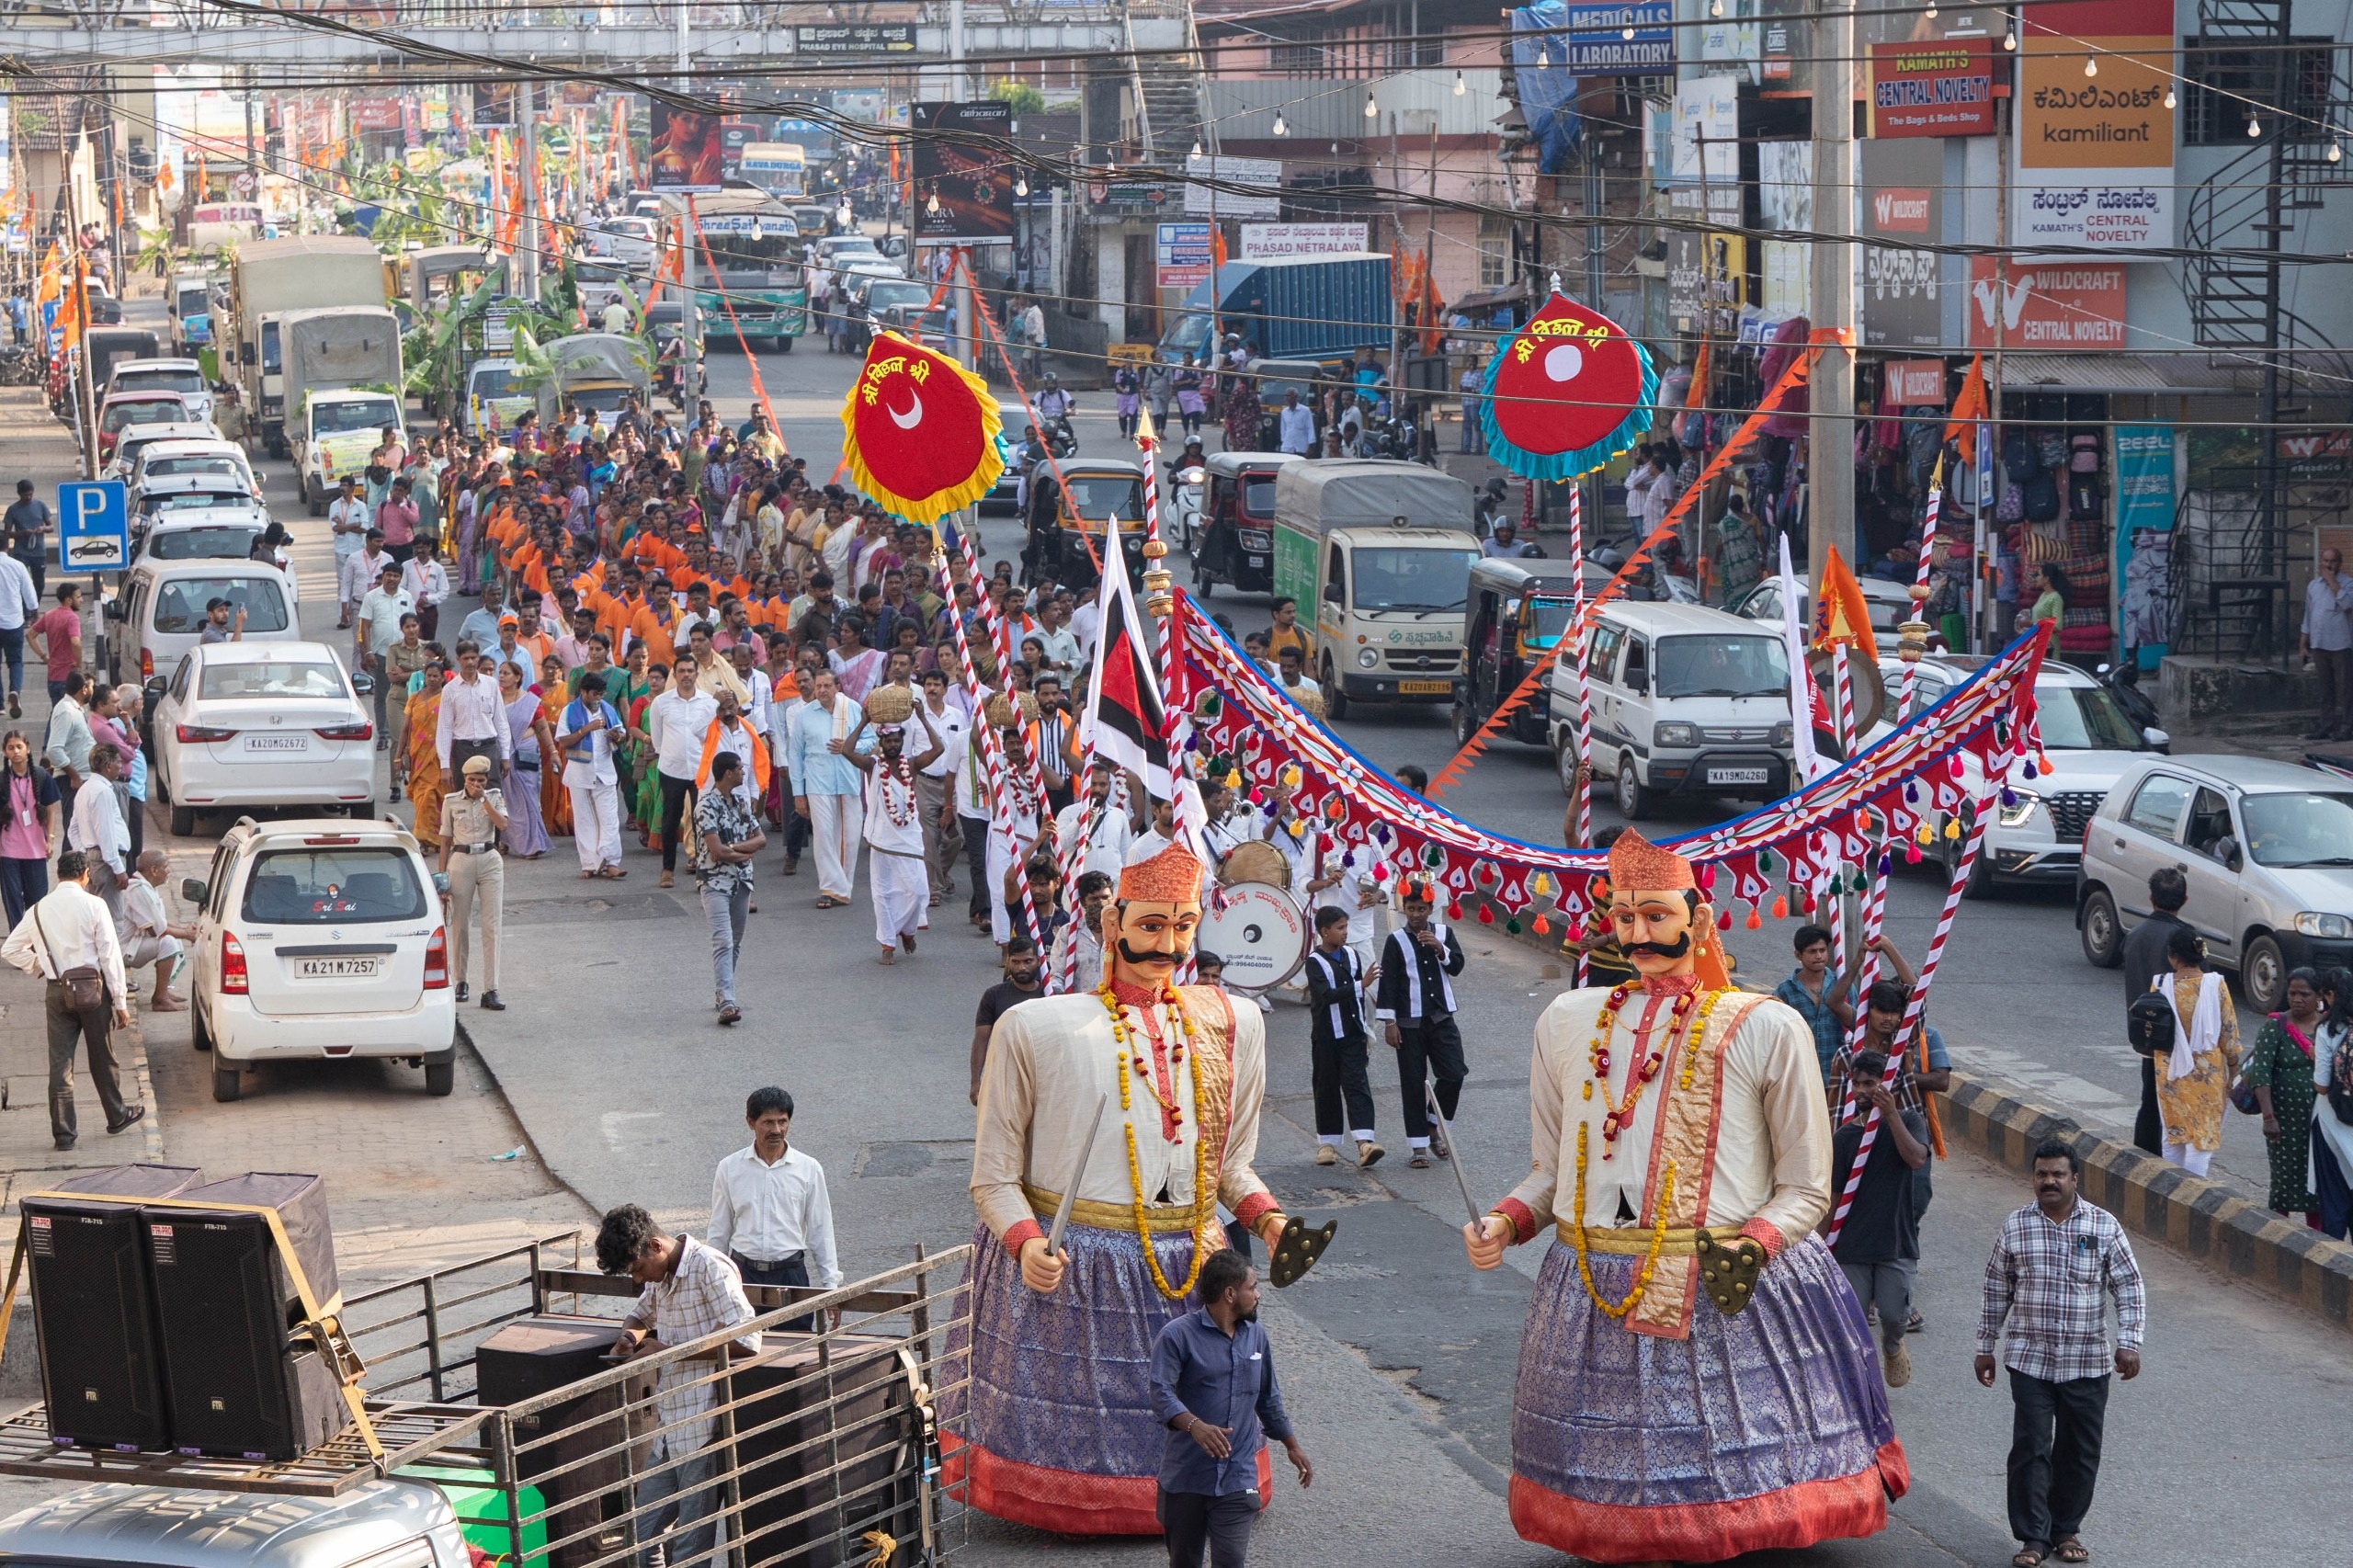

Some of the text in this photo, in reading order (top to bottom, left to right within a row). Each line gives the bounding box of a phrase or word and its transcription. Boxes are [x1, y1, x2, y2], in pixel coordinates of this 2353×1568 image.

[1572, 8, 1668, 35] MEDICALS
[1572, 42, 1671, 70] LABORATORY
[1896, 50, 1969, 73] KAMATH'S
[1875, 75, 1991, 108] CENTRAL NOVELTY
[1888, 113, 1981, 126] The Bags & Beds Shop
[2043, 122, 2149, 142] kamiliant
[2032, 188, 2088, 216] ಸೆಂಟ್ರಲ್
[922, 208, 955, 218] AURA
[1892, 200, 1927, 219] WILDCRAFT
[731, 217, 795, 233] Satyanath
[2086, 215, 2149, 226] CENTRAL
[2031, 223, 2084, 233] KAMATH'S
[2086, 231, 2148, 242] NOVELTY
[1246, 243, 1361, 253] PRASAD NETRALAYA
[2036, 271, 2121, 290] WILDCRAFT
[2024, 321, 2122, 341] CENTRAL NOVELTY
[1905, 371, 1939, 396] WILDCRAFT
[77, 489, 106, 529] P
[251, 738, 306, 749] KA20MG2672
[1713, 771, 1767, 781] KA19MD4260
[313, 901, 357, 913] Sri Sai
[303, 961, 375, 974] KA 21 M 7257
[85, 1391, 97, 1401] FTR
[211, 1400, 223, 1410] FTR
